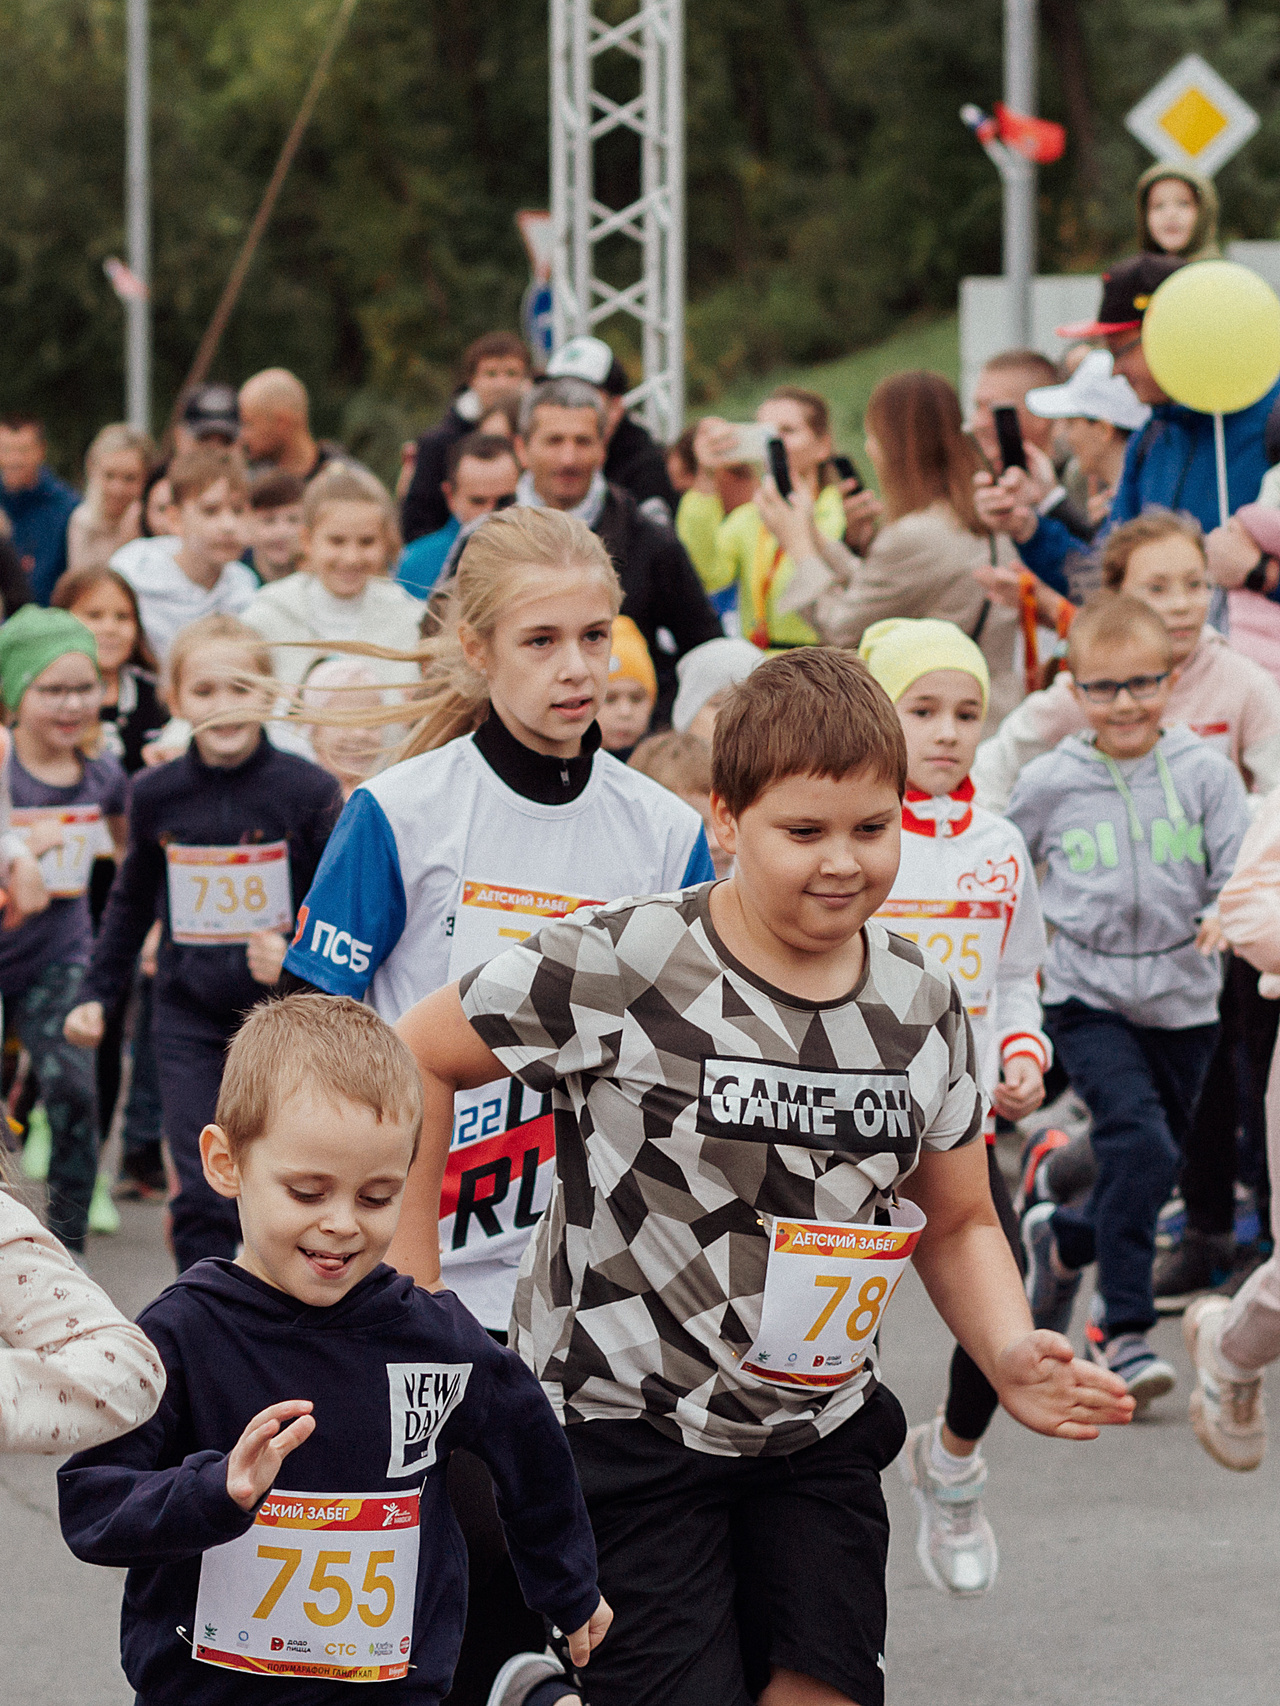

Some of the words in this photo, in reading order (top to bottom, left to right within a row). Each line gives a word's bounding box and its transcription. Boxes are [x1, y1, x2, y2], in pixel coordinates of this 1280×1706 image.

[190, 875, 268, 914] 738
[477, 889, 534, 907] ДЕТСКИЙ
[535, 897, 570, 912] ЗАБЕГ
[310, 919, 373, 973] ПСБ
[710, 1075, 836, 1135] GAME
[853, 1088, 911, 1138] ON
[792, 1231, 856, 1249] ДЕТСКИЙ
[858, 1237, 897, 1251] ЗАБЕГ
[803, 1275, 900, 1341] 78
[259, 1502, 304, 1519] СКИЙ
[306, 1506, 350, 1521] ЗАБЕГ
[251, 1545, 395, 1628] 755
[286, 1645, 312, 1653] ПИЦЦА
[324, 1642, 357, 1656] СТС
[267, 1662, 330, 1675] ПОЛУМАРАФОН
[332, 1668, 373, 1678] ГАНДИКАП
